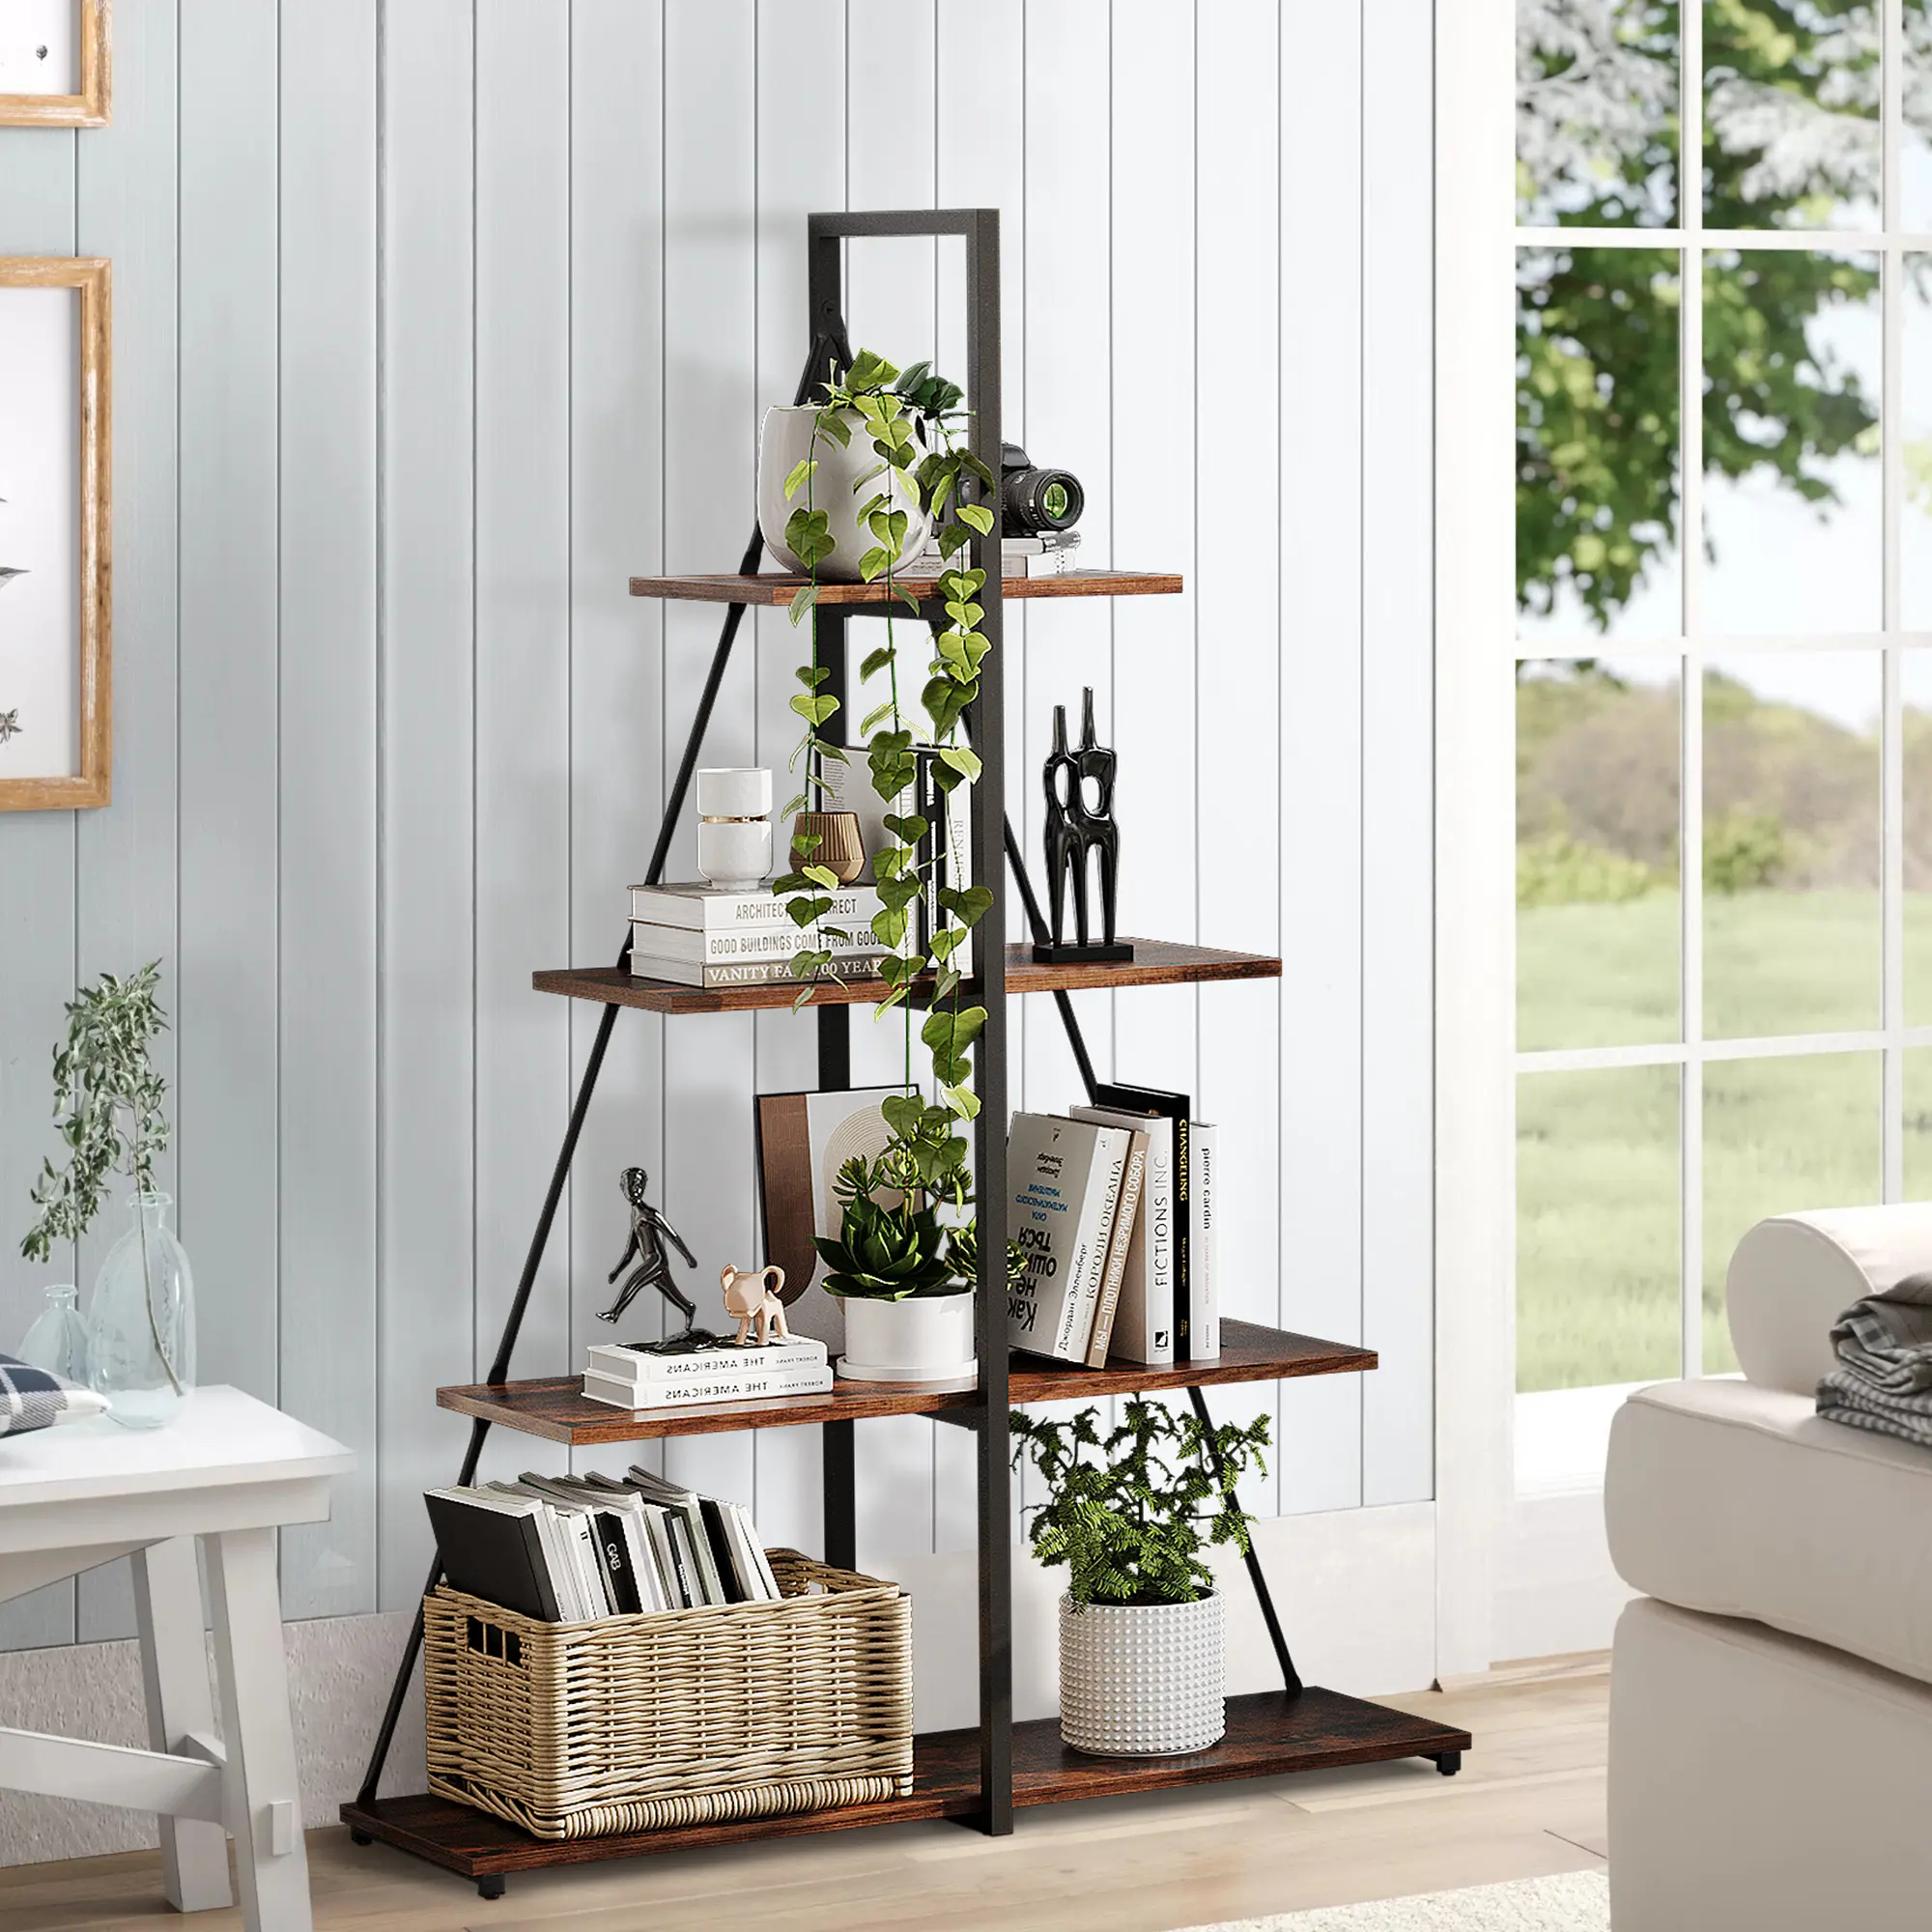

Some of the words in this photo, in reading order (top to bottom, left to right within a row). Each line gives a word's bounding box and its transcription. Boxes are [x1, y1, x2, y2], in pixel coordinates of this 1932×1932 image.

[828, 898, 857, 915] RECT
[710, 938, 737, 954] GOOD
[741, 934, 791, 952] BUILDINGS
[826, 931, 854, 948] FROM
[709, 966, 771, 981] VANITY
[841, 958, 883, 975] YEAR
[1154, 1151, 1168, 1188] INC.
[1179, 1119, 1188, 1202] CHANGELING
[1201, 1148, 1210, 1185] pierre
[1203, 1189, 1211, 1230] cardin
[1017, 1226, 1051, 1252] ться
[1086, 1232, 1107, 1299] КОРОЛИ
[1101, 1159, 1122, 1227] ОКЕАНА
[1154, 1197, 1168, 1286] FICTIONS
[1020, 1253, 1057, 1278] оши
[1094, 1329, 1108, 1350] МЫ
[1102, 1258, 1122, 1315] ПЛОТНИКИ
[1114, 1193, 1136, 1256] НЕЗРИМОГО
[1126, 1150, 1146, 1192] СОБОРА
[1015, 1277, 1037, 1297] не
[1058, 1302, 1074, 1351] Джордан
[1068, 1243, 1088, 1298] Элленберг
[1008, 1297, 1037, 1332] Как
